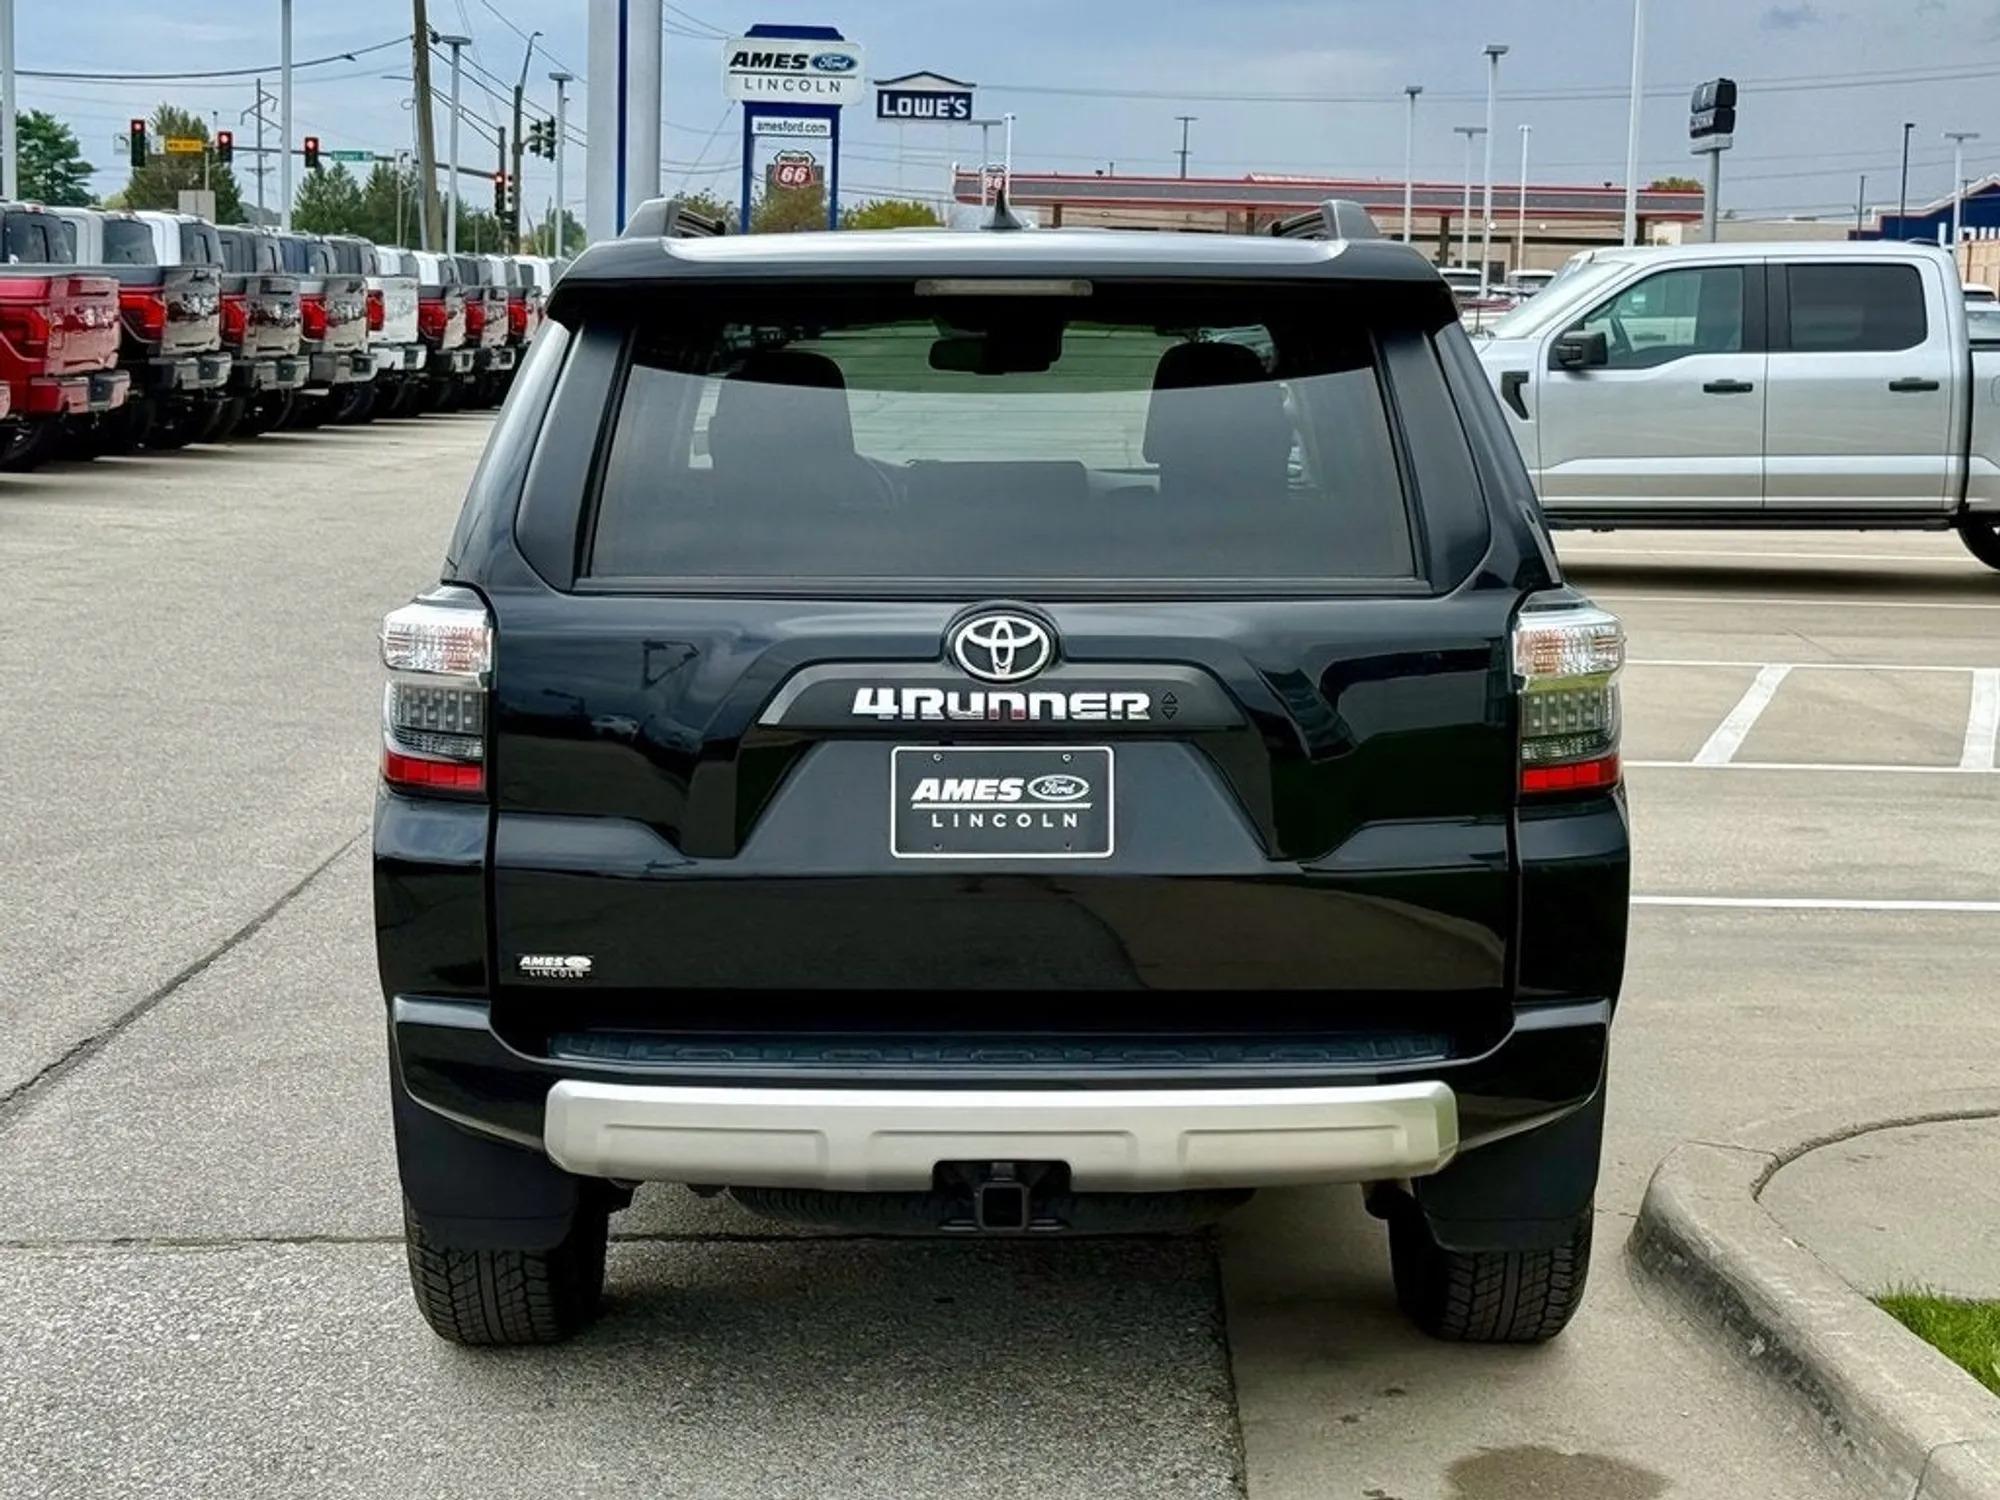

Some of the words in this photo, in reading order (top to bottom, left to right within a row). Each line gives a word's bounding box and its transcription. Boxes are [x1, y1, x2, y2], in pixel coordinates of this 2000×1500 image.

[729, 51, 809, 70] AMES
[744, 77, 841, 93] LINCOLN
[882, 93, 967, 118] LOWE'S
[756, 120, 828, 134] amesford.com
[781, 166, 808, 183] 66
[911, 778, 1025, 801] AMES
[932, 813, 1078, 828] LINCOLN
[519, 956, 564, 966] AMES
